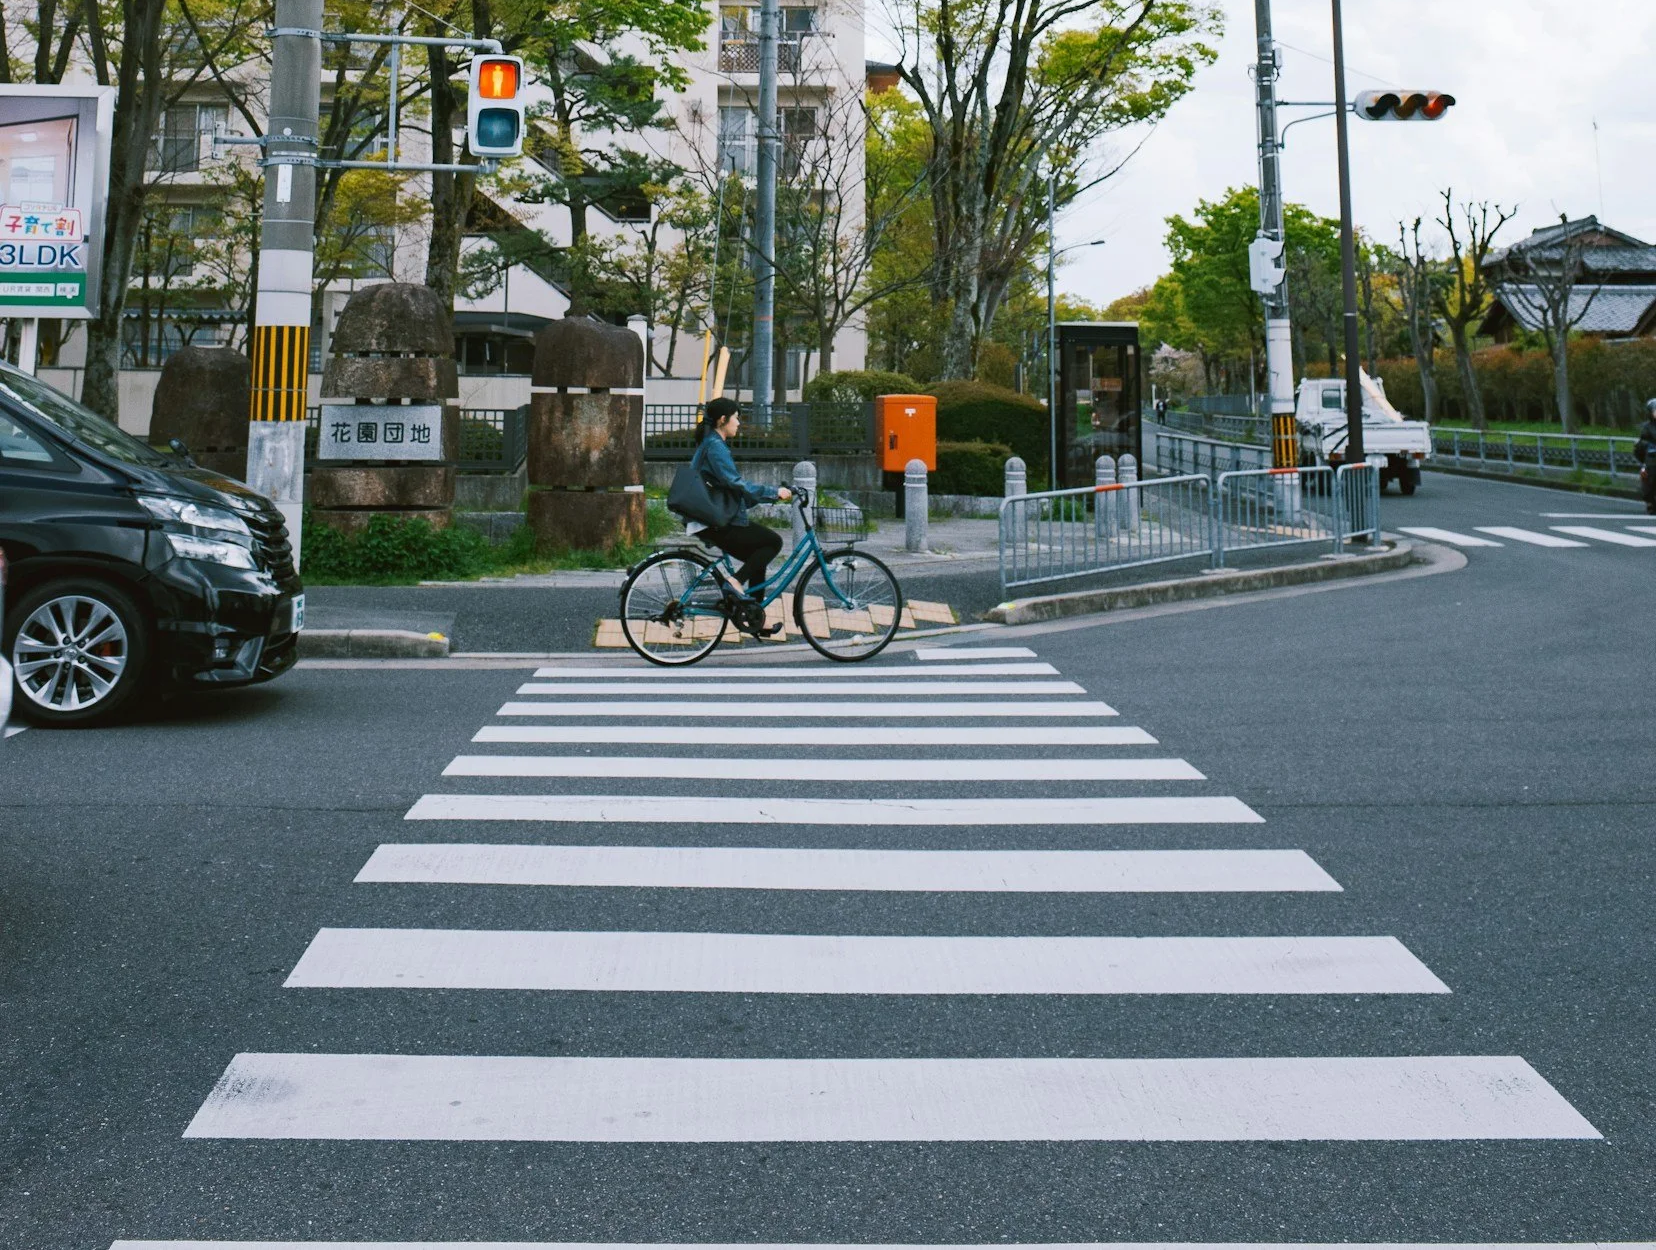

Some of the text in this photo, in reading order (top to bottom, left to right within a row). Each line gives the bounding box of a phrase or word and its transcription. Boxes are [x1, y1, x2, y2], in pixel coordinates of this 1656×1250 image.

[5, 215, 75, 236] 子育て割
[0, 244, 79, 266] 3LDK
[330, 421, 431, 444] 花園団地
